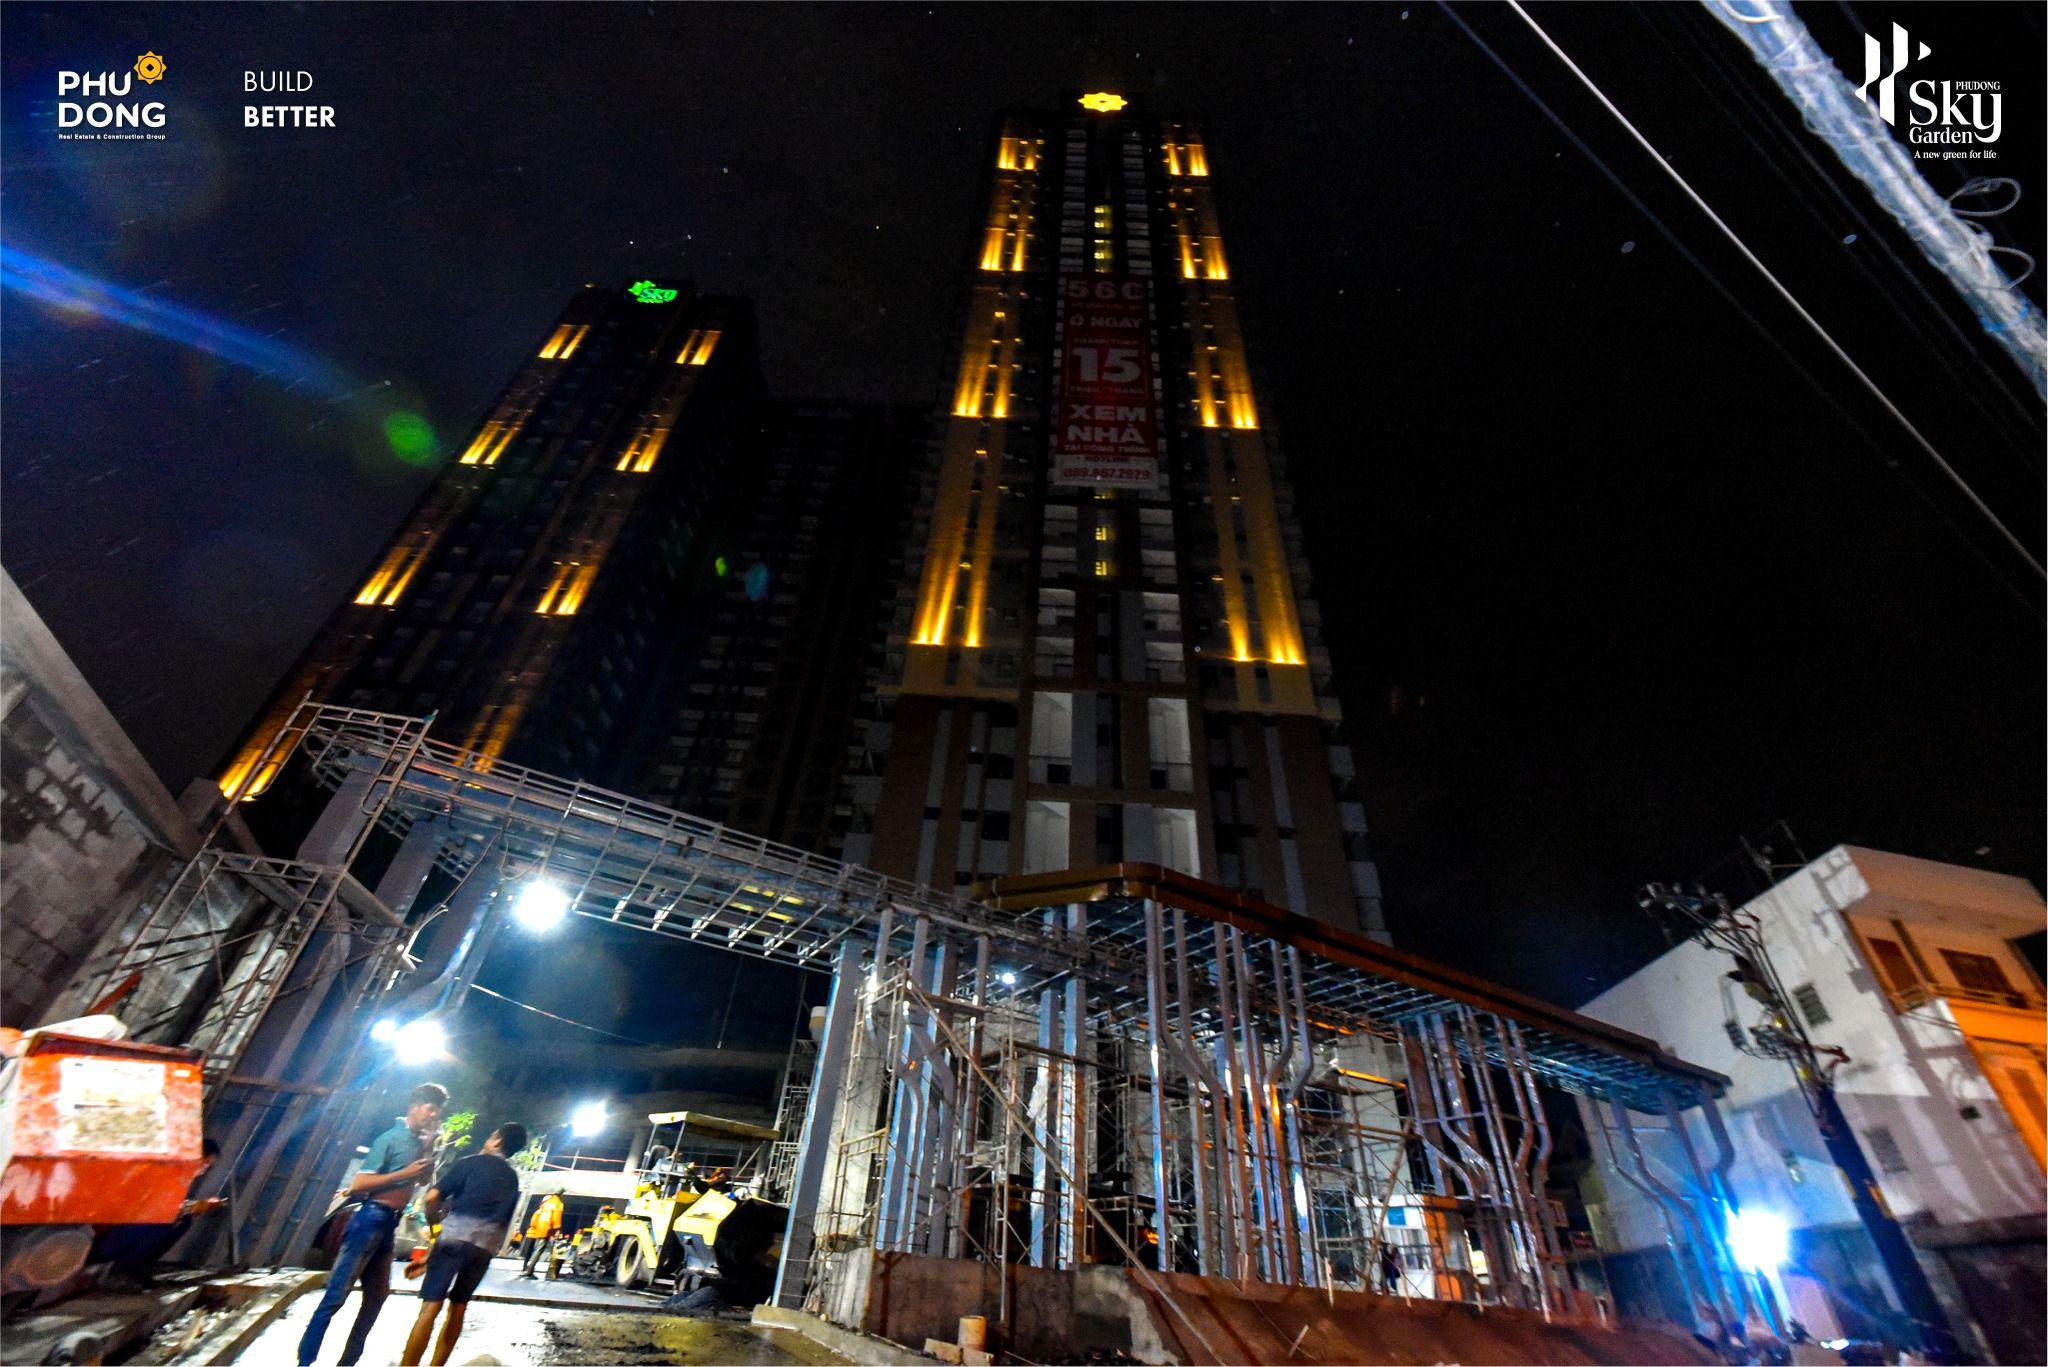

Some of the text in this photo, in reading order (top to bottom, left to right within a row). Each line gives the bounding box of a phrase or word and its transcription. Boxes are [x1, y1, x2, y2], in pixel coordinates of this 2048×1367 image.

[1090, 316, 1143, 329] NGAY
[1071, 347, 1142, 382] 15
[1068, 404, 1147, 423] XEM
[1066, 423, 1147, 445] NHÀ
